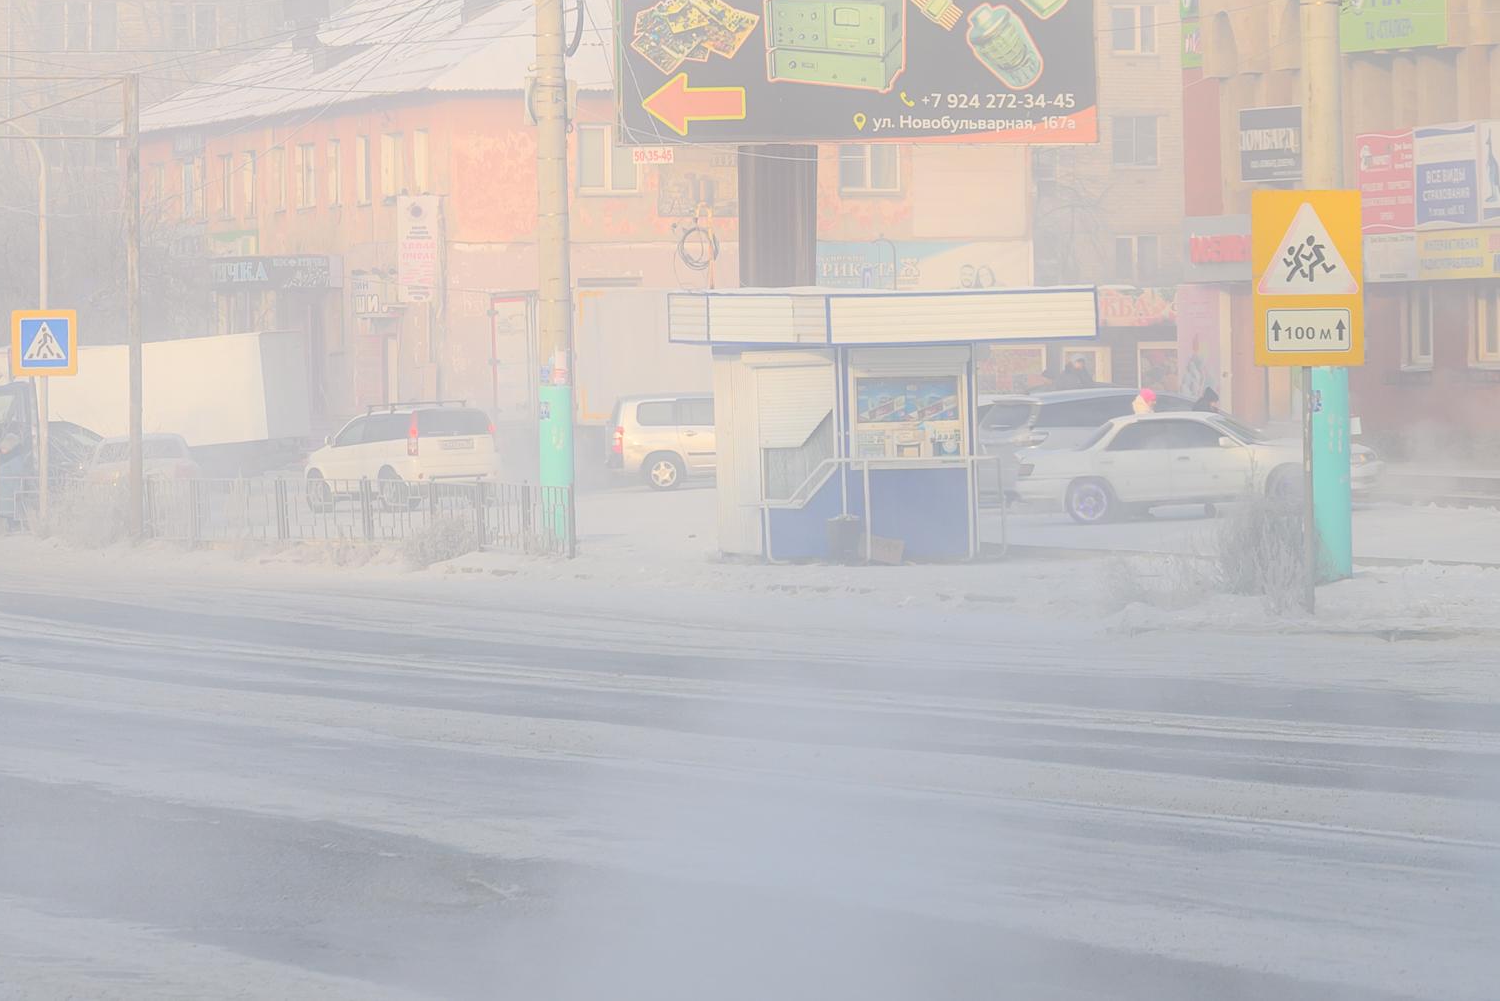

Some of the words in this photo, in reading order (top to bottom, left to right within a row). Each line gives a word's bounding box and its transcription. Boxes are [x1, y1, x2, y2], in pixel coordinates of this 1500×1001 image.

[920, 93, 944, 109] +7
[946, 93, 980, 109] 924
[985, 93, 1076, 109] 272-34-45
[872, 116, 895, 132] ул.
[899, 115, 1038, 132] Новобульварная,
[1041, 115, 1076, 131] 167а
[634, 149, 673, 163] 50-35-45
[1284, 326, 1316, 341] 100
